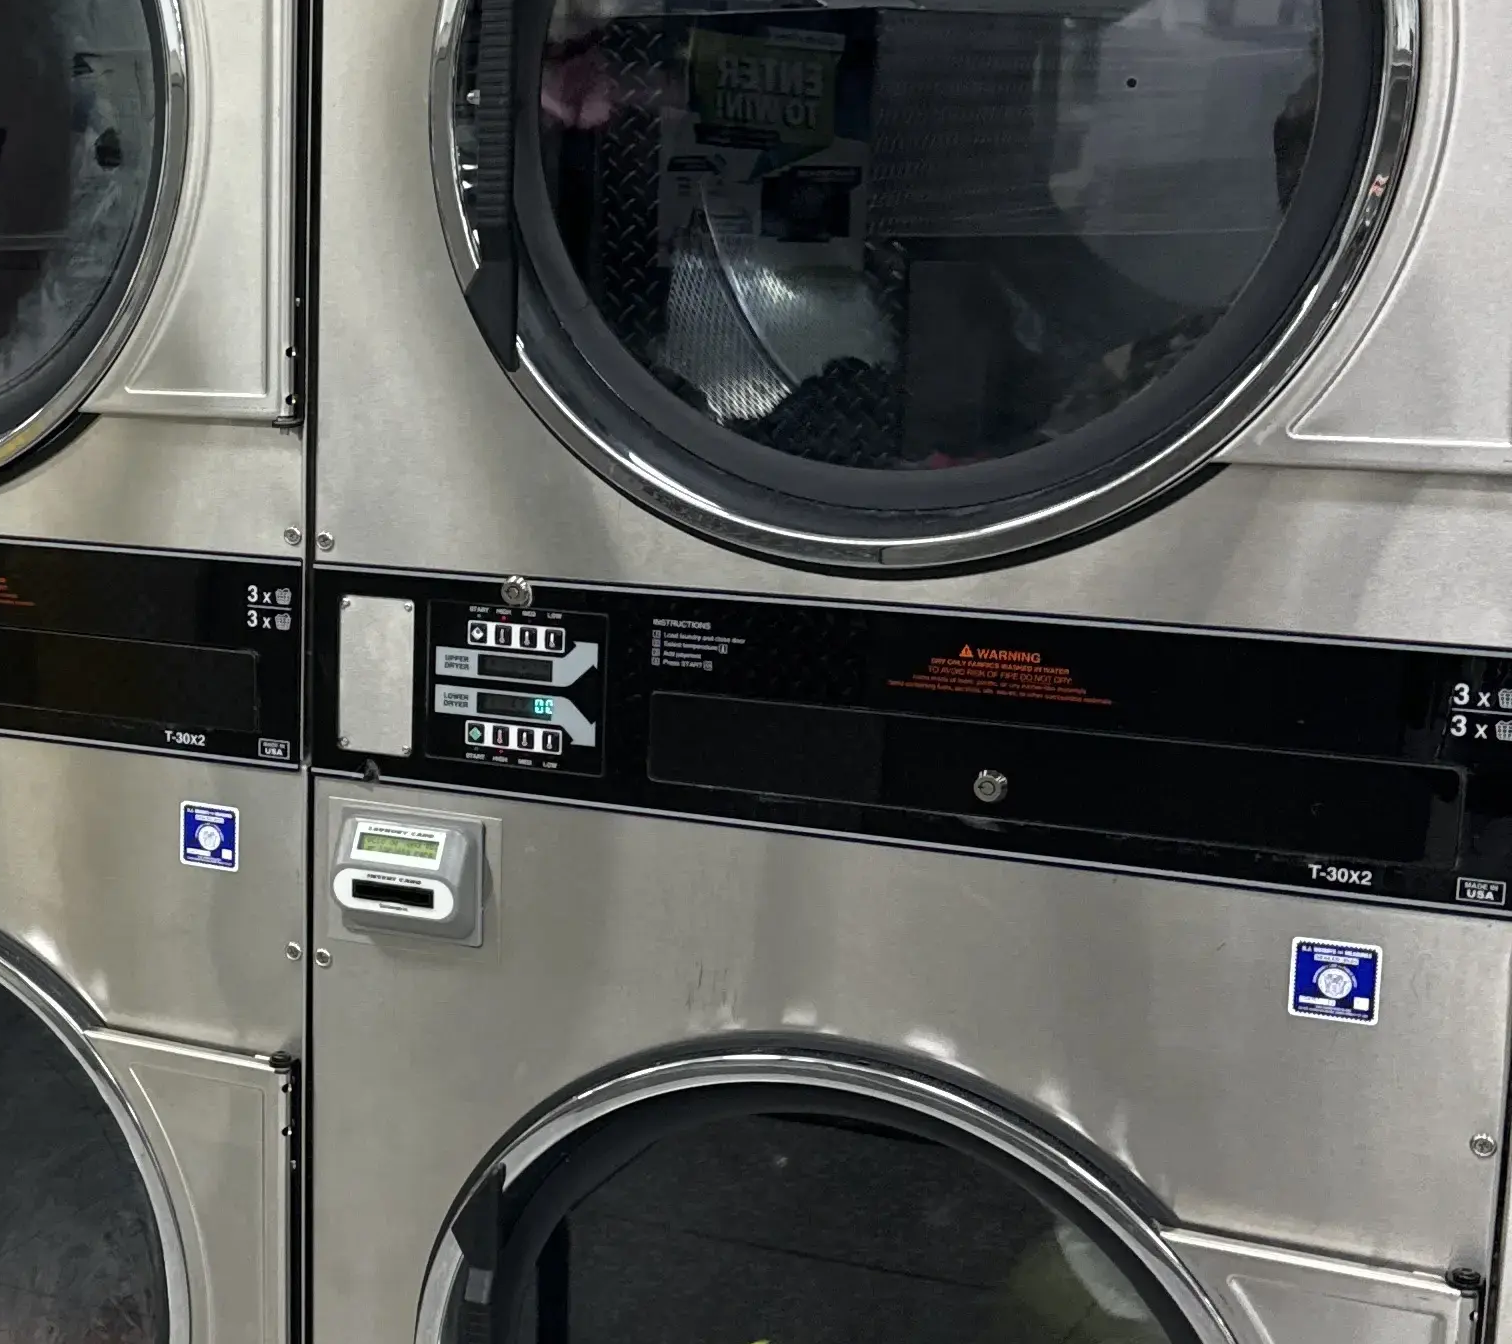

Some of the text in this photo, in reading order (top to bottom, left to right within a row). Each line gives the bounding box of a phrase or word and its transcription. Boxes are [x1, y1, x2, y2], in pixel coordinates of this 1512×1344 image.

[246, 584, 272, 605] 3 x
[246, 609, 272, 630] 3 x
[652, 618, 712, 630] INSTRUCTIONS
[444, 653, 470, 663] UPPER
[977, 647, 1041, 664] WARNING
[444, 660, 470, 670] DRYER
[928, 664, 940, 674] TO
[940, 666, 966, 676] AVOID
[966, 668, 986, 677] RISK
[986, 670, 999, 678] OF
[1033, 674, 1053, 684] NOT
[443, 691, 469, 700] LOWER
[1453, 682, 1491, 707] 3 x
[443, 699, 469, 709] DRYER
[1449, 714, 1488, 739] 3 x
[164, 729, 206, 747] T-30X2
[264, 747, 283, 756] USA
[1307, 863, 1373, 886] T-30X2
[1464, 881, 1488, 891] MADE
[1466, 890, 1494, 901] USA
